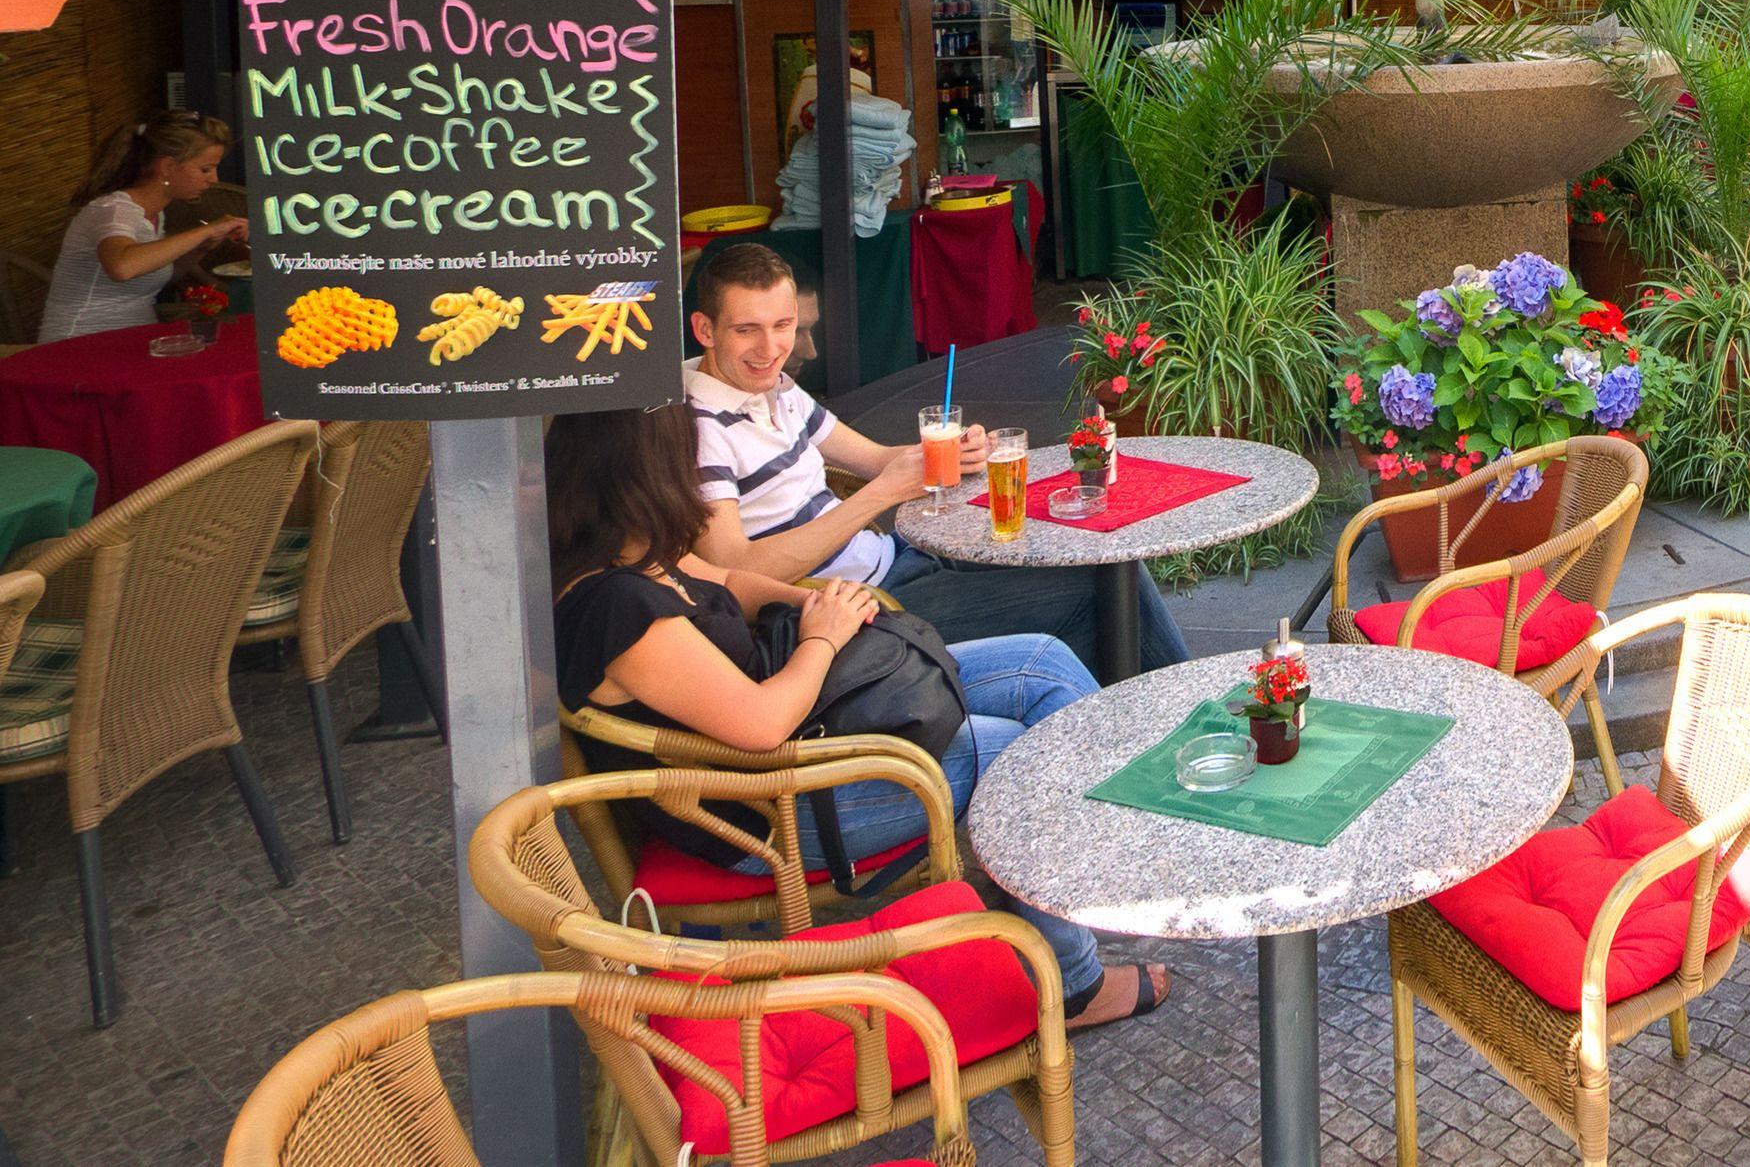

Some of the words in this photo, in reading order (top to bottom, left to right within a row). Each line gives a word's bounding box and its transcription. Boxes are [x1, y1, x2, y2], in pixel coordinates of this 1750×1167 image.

[268, 252, 386, 276] Vyzkoušejte
[388, 250, 434, 271] naše
[438, 250, 487, 271] nové
[490, 248, 571, 270] lahodné
[574, 248, 659, 274] výrobky:
[317, 381, 377, 396] Seasoned
[517, 378, 531, 391] &
